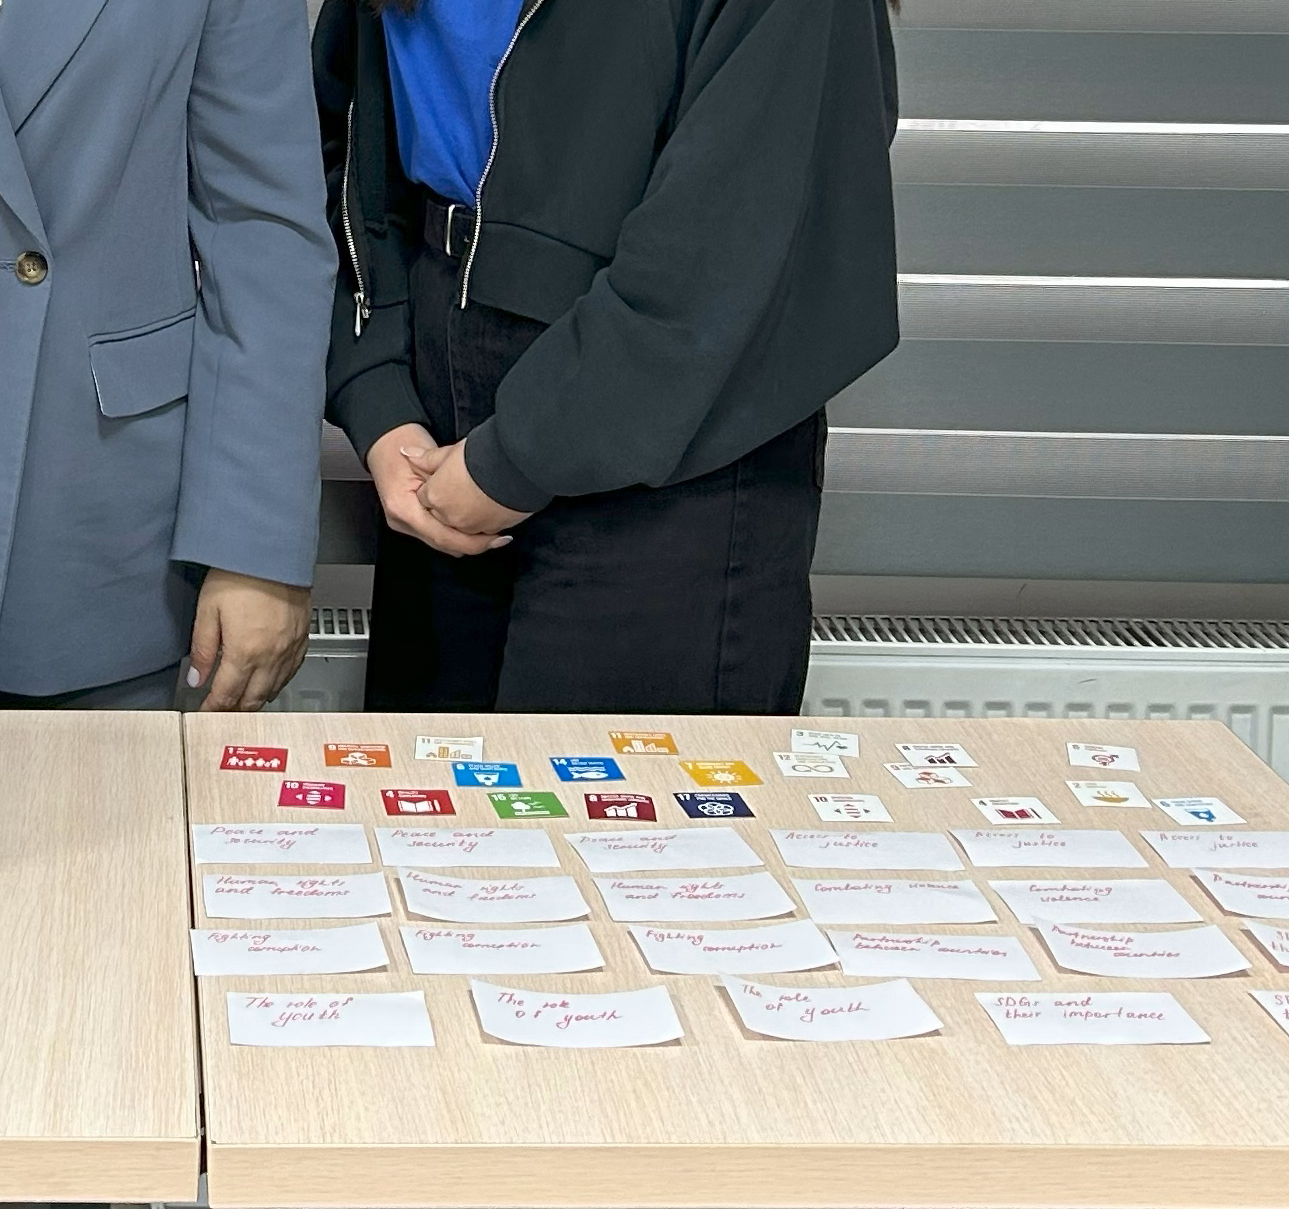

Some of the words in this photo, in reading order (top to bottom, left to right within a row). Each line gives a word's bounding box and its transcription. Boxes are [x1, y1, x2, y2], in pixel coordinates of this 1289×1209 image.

[285, 781, 300, 789] 10
[277, 827, 319, 836] and
[245, 996, 275, 1008] The
[286, 997, 318, 1008] role
[328, 996, 354, 1008] of
[497, 992, 525, 1007] The
[1054, 996, 1092, 1007] and
[271, 1009, 341, 1028] youth
[555, 1010, 624, 1029] youth
[1005, 1008, 1042, 1019] their
[1063, 1007, 1165, 1021] importance
